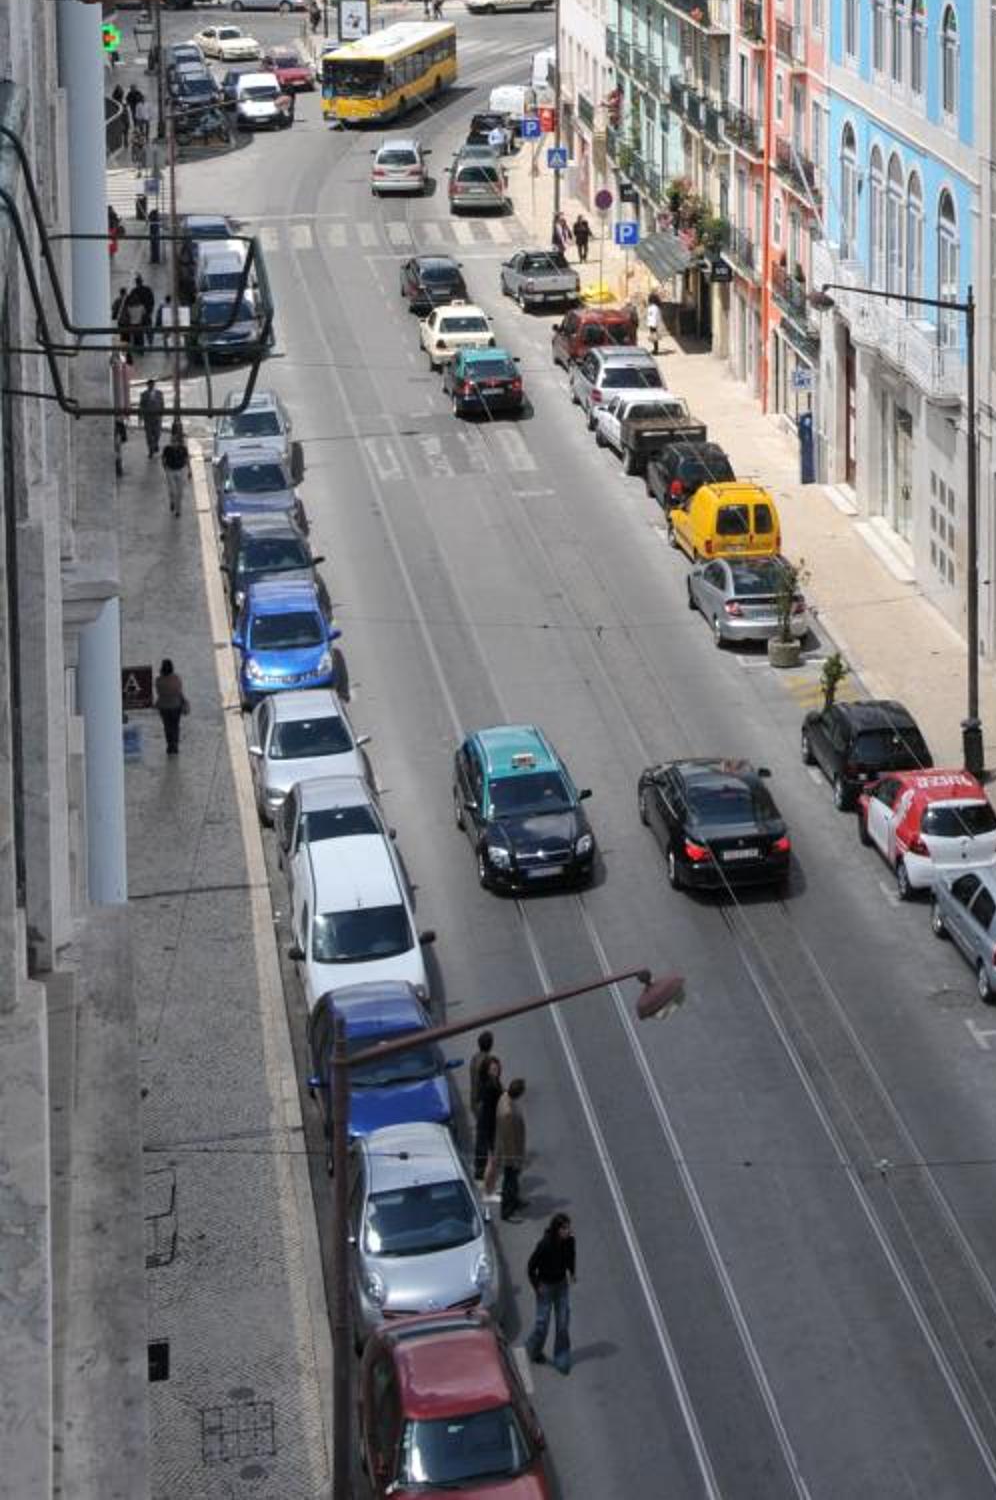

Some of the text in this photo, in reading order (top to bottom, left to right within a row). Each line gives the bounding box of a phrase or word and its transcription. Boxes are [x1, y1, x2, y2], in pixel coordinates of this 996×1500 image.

[526, 121, 537, 135] P
[620, 225, 633, 242] P
[123, 673, 143, 692] A
